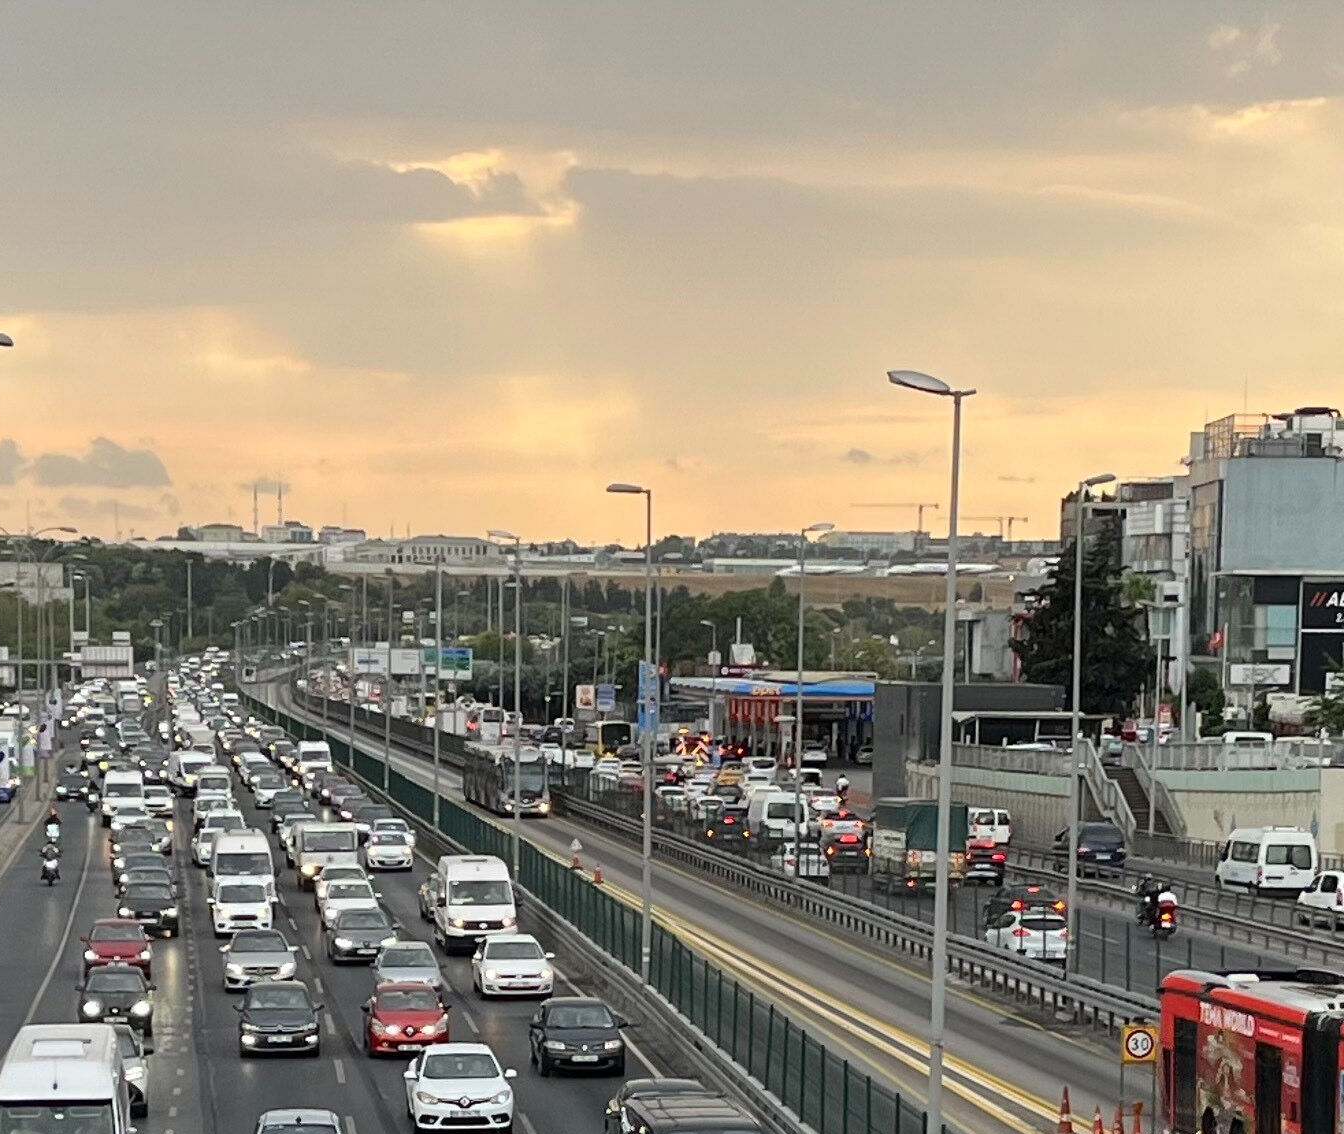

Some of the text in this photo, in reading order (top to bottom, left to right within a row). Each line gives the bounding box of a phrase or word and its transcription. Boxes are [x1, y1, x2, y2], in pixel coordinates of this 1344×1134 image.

[1199, 1001, 1224, 1029] TEMA
[1223, 1007, 1256, 1037] WORLD
[1131, 1037, 1149, 1052] 30
